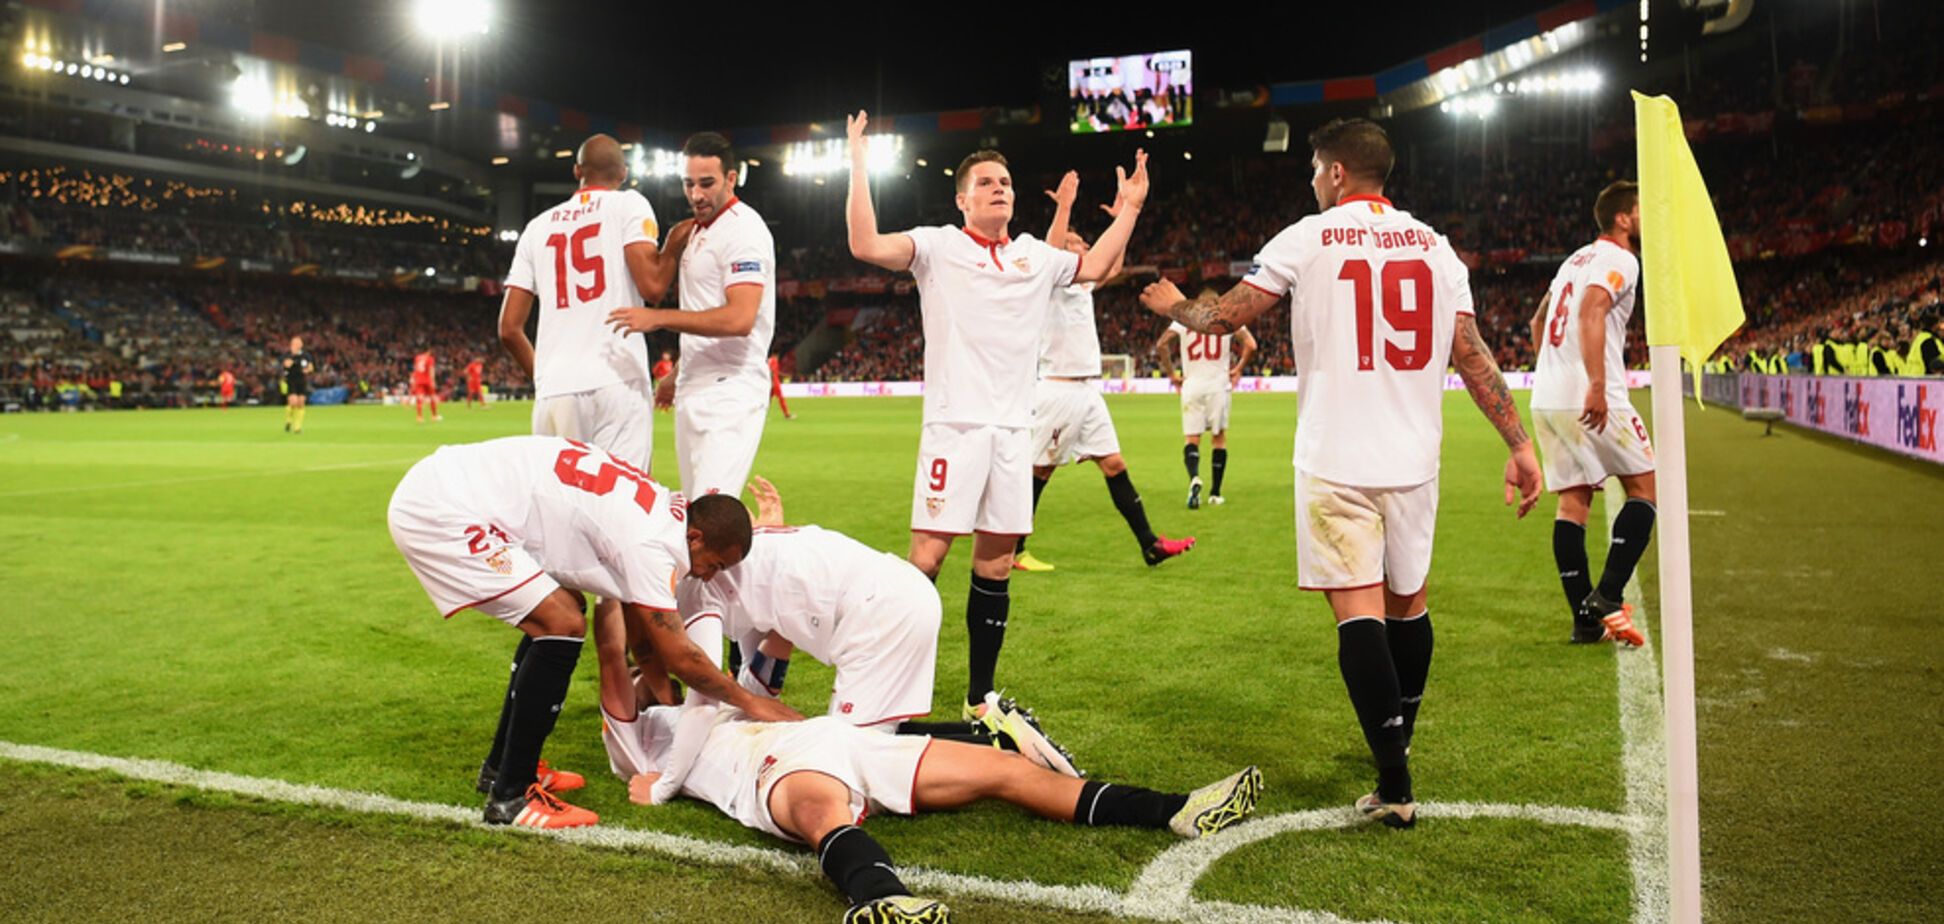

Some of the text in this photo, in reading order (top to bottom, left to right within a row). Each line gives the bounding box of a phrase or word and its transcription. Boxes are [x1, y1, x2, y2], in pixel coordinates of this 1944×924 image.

[1321, 228, 1367, 246] ever
[546, 222, 606, 308] 15
[1338, 259, 1433, 370] 19
[1550, 281, 1573, 347] 6
[1187, 329, 1222, 361] 20
[1807, 380, 1826, 425] FedEx
[1844, 382, 1870, 436] FedEx
[1898, 384, 1937, 452] FedEx
[1632, 416, 1648, 442] 6
[929, 458, 948, 492] 9
